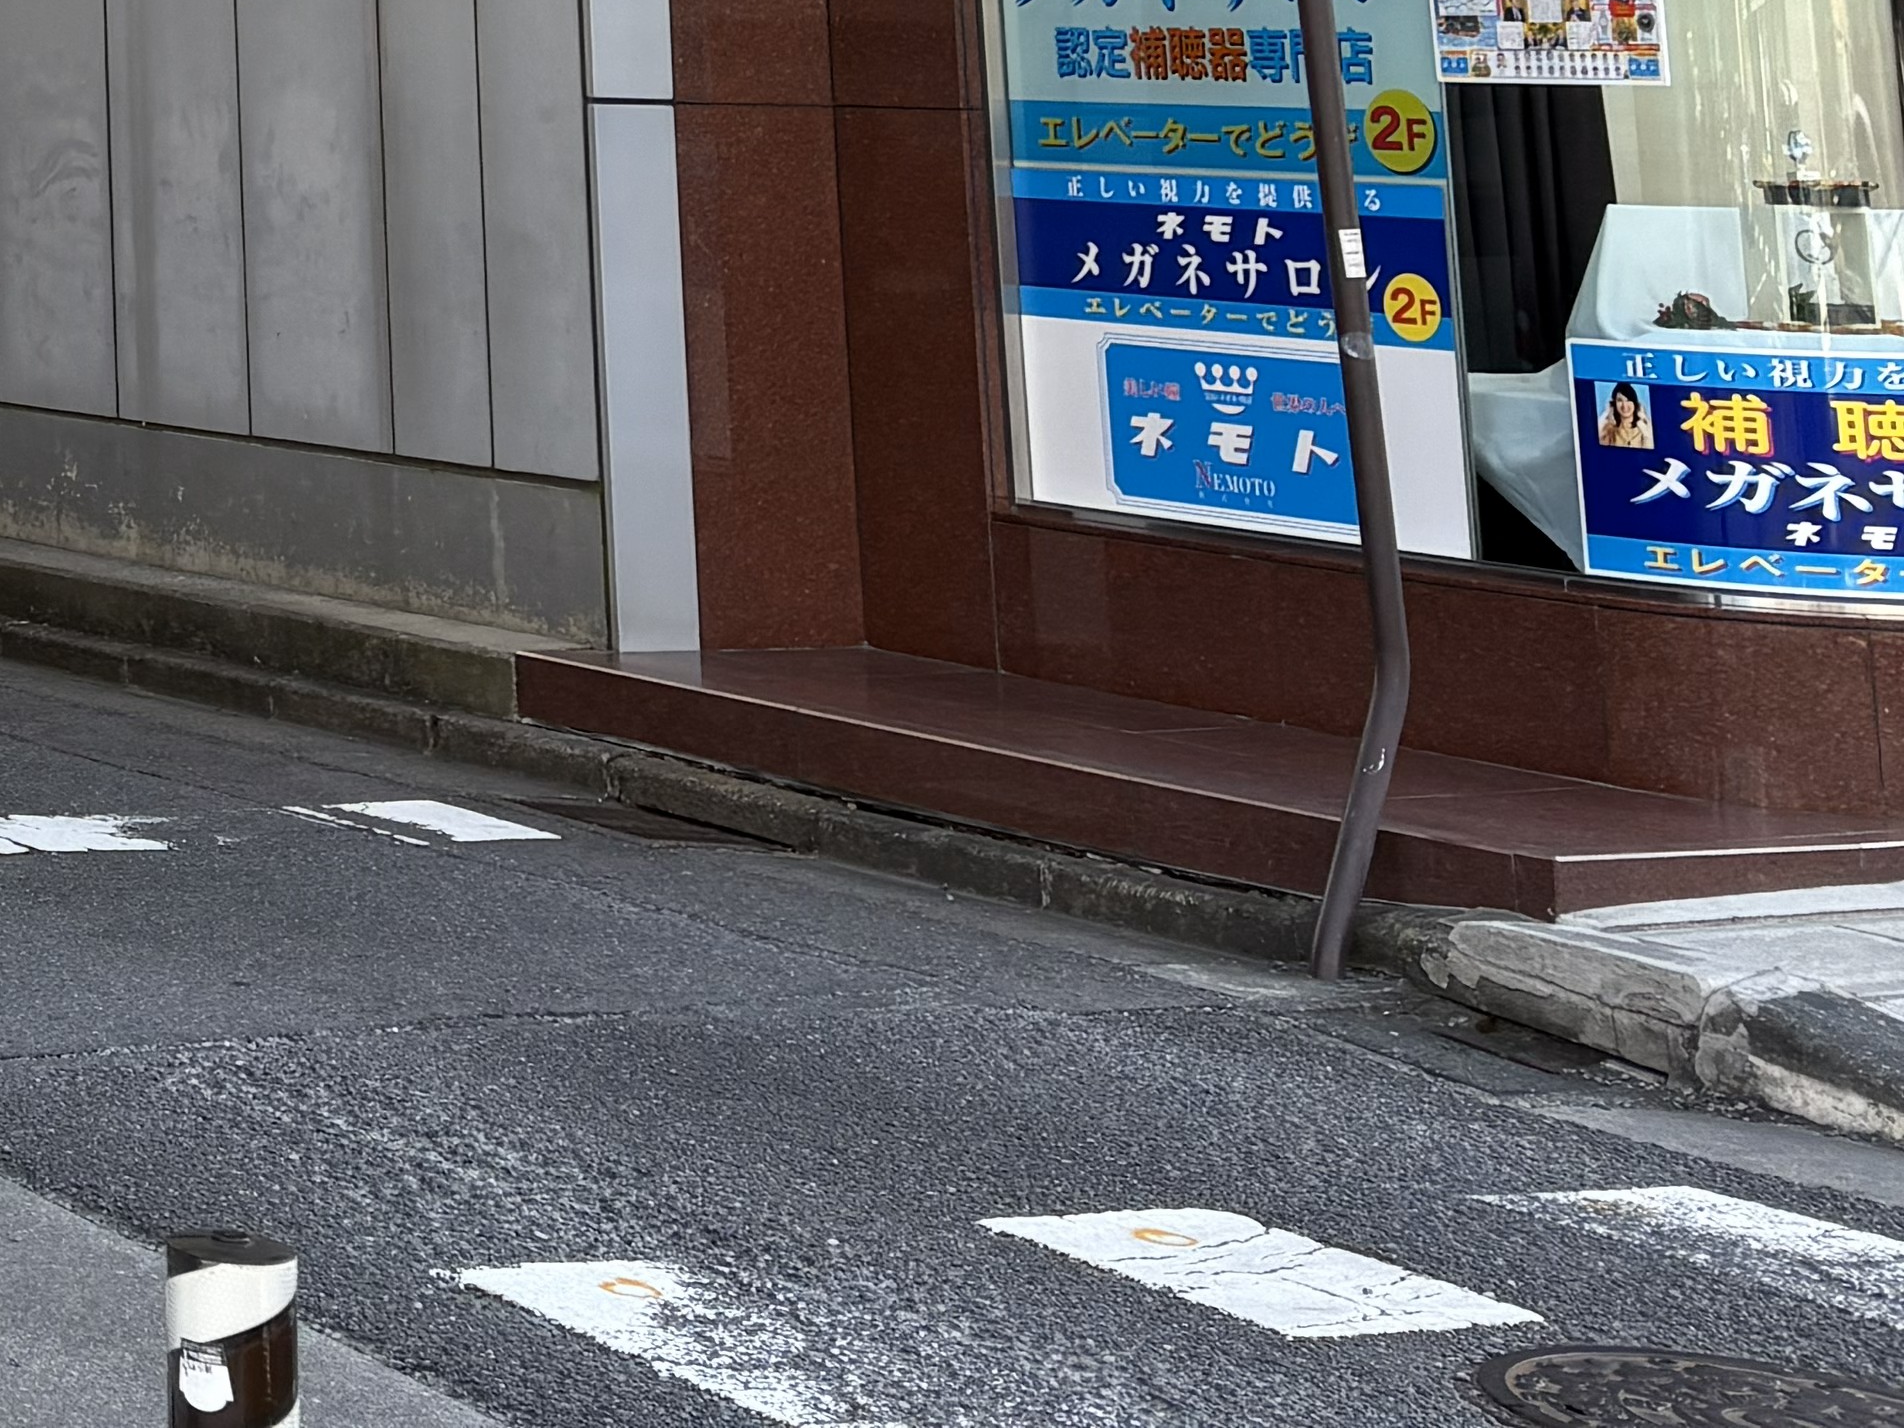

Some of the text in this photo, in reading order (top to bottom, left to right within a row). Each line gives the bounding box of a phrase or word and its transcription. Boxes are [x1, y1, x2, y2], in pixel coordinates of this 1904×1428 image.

[1369, 104, 1430, 153] 2F
[1066, 175, 1382, 212] 正しい視力を提供る
[1156, 212, 1284, 246] ネモト
[1083, 296, 1374, 339] エレベーターでどう
[1390, 286, 1438, 328] 2F
[1622, 352, 1904, 393] 正しい視力を
[1129, 412, 1340, 475] ネモト
[1680, 392, 1904, 464] 補聴
[1193, 460, 1276, 498] NEMOTO
[1785, 521, 1898, 551] ネモ
